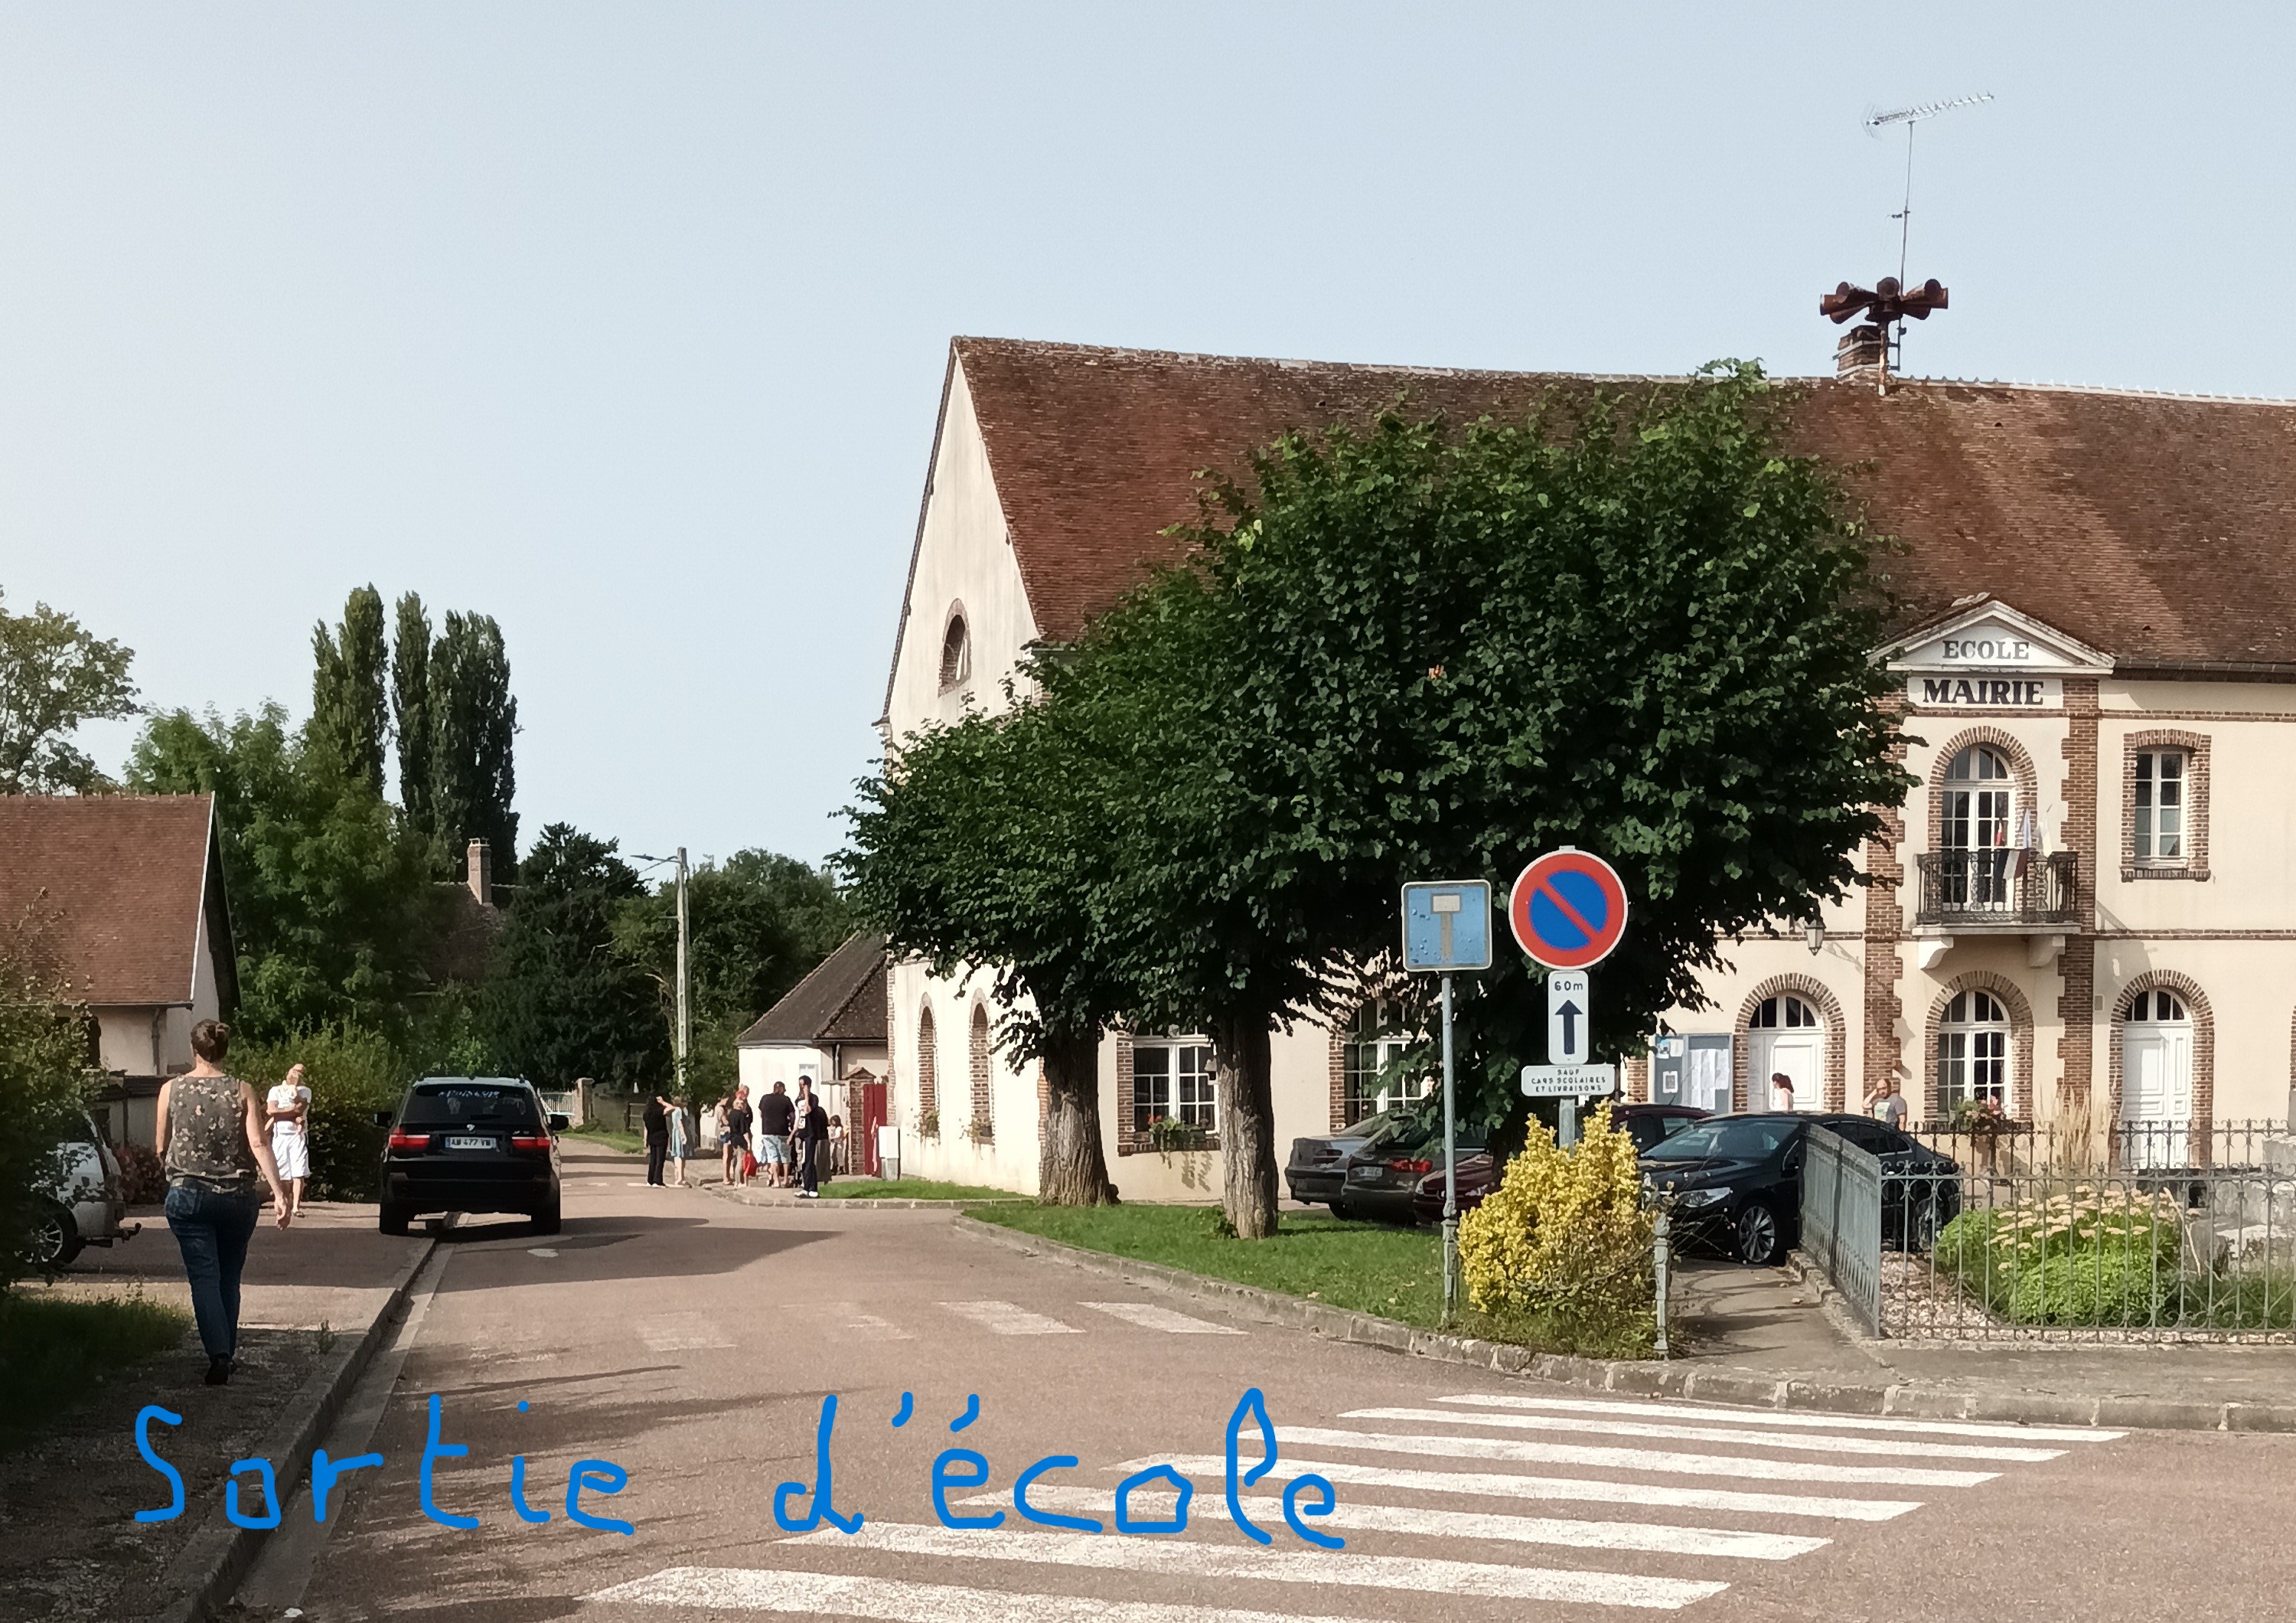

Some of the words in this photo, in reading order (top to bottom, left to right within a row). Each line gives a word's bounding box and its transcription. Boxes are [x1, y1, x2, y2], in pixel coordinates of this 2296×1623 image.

[1942, 640, 2029, 659] ECOLE
[1923, 679, 2043, 705] MAIRIE
[1554, 981, 1583, 991] 60m
